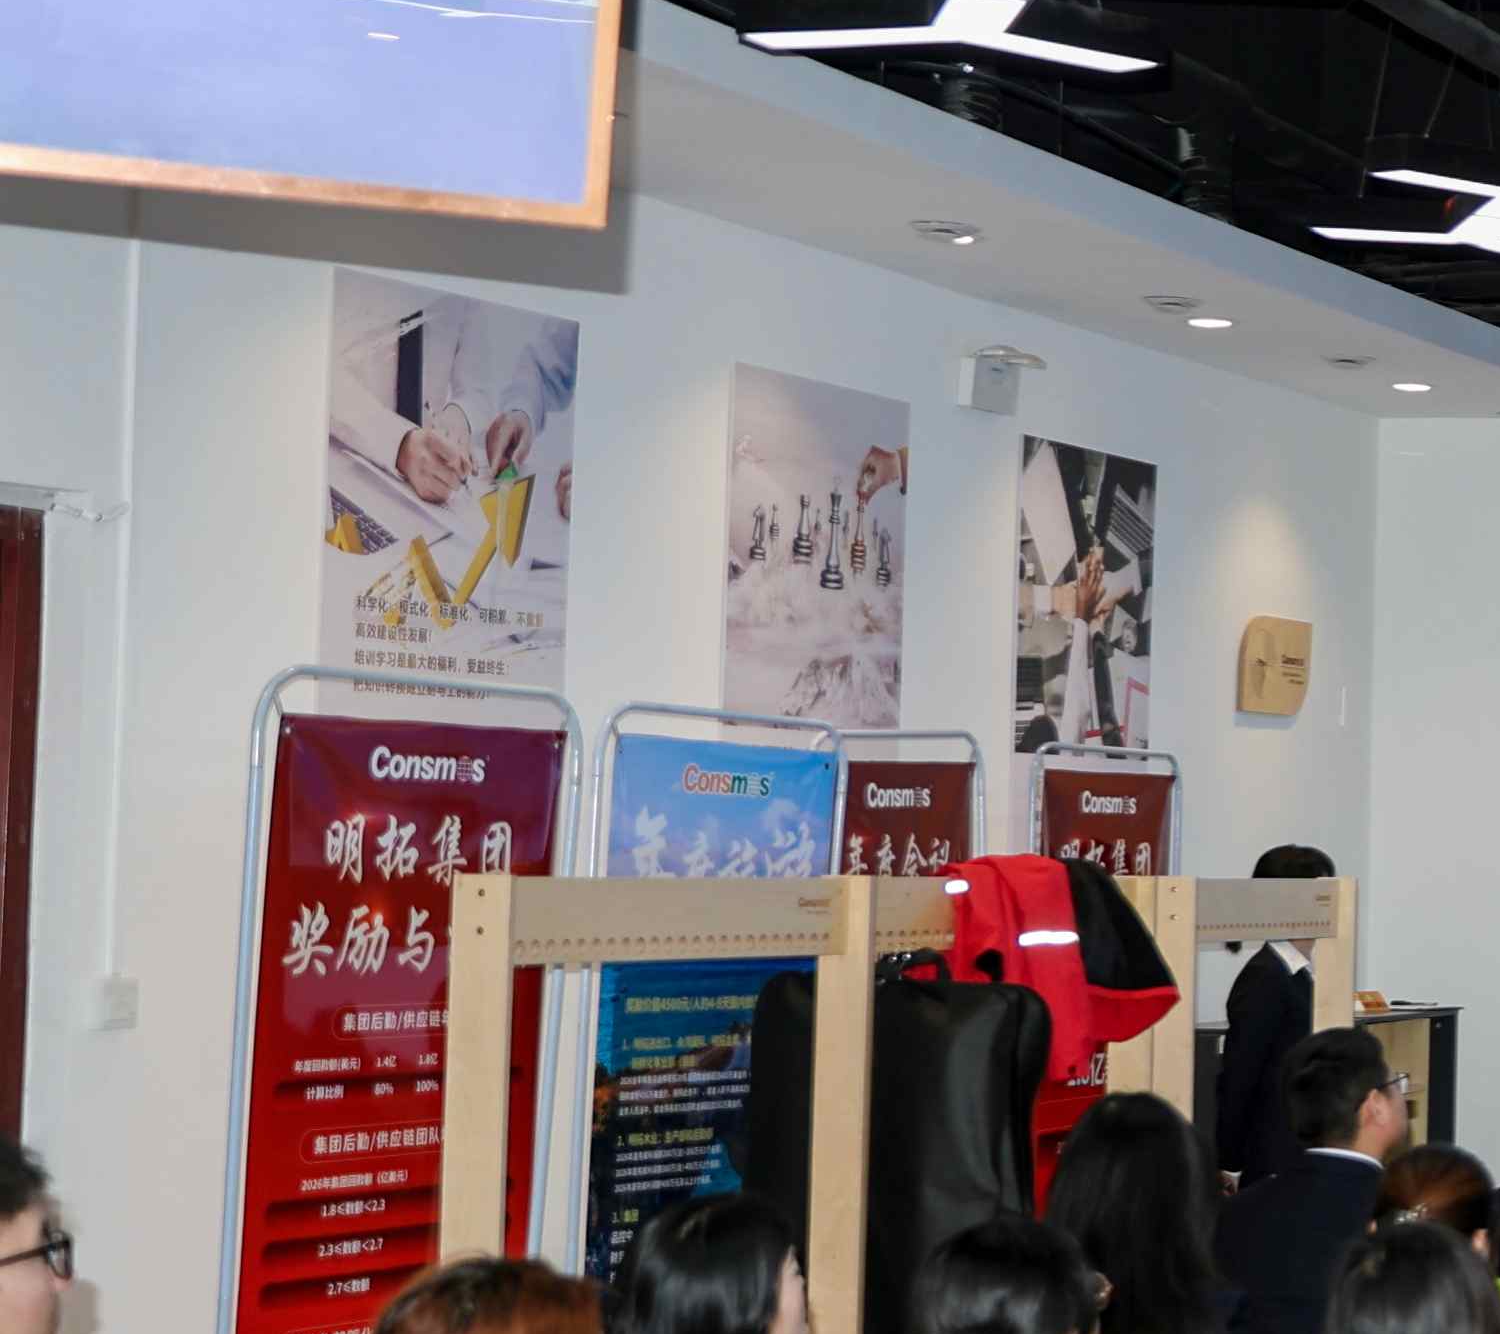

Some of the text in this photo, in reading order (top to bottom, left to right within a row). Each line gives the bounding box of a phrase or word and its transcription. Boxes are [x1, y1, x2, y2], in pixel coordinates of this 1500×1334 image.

[325, 813, 513, 885] 明拓集团
[282, 900, 452, 977] 奖励与
[313, 1126, 443, 1156] 集团后勤/供应链团队
